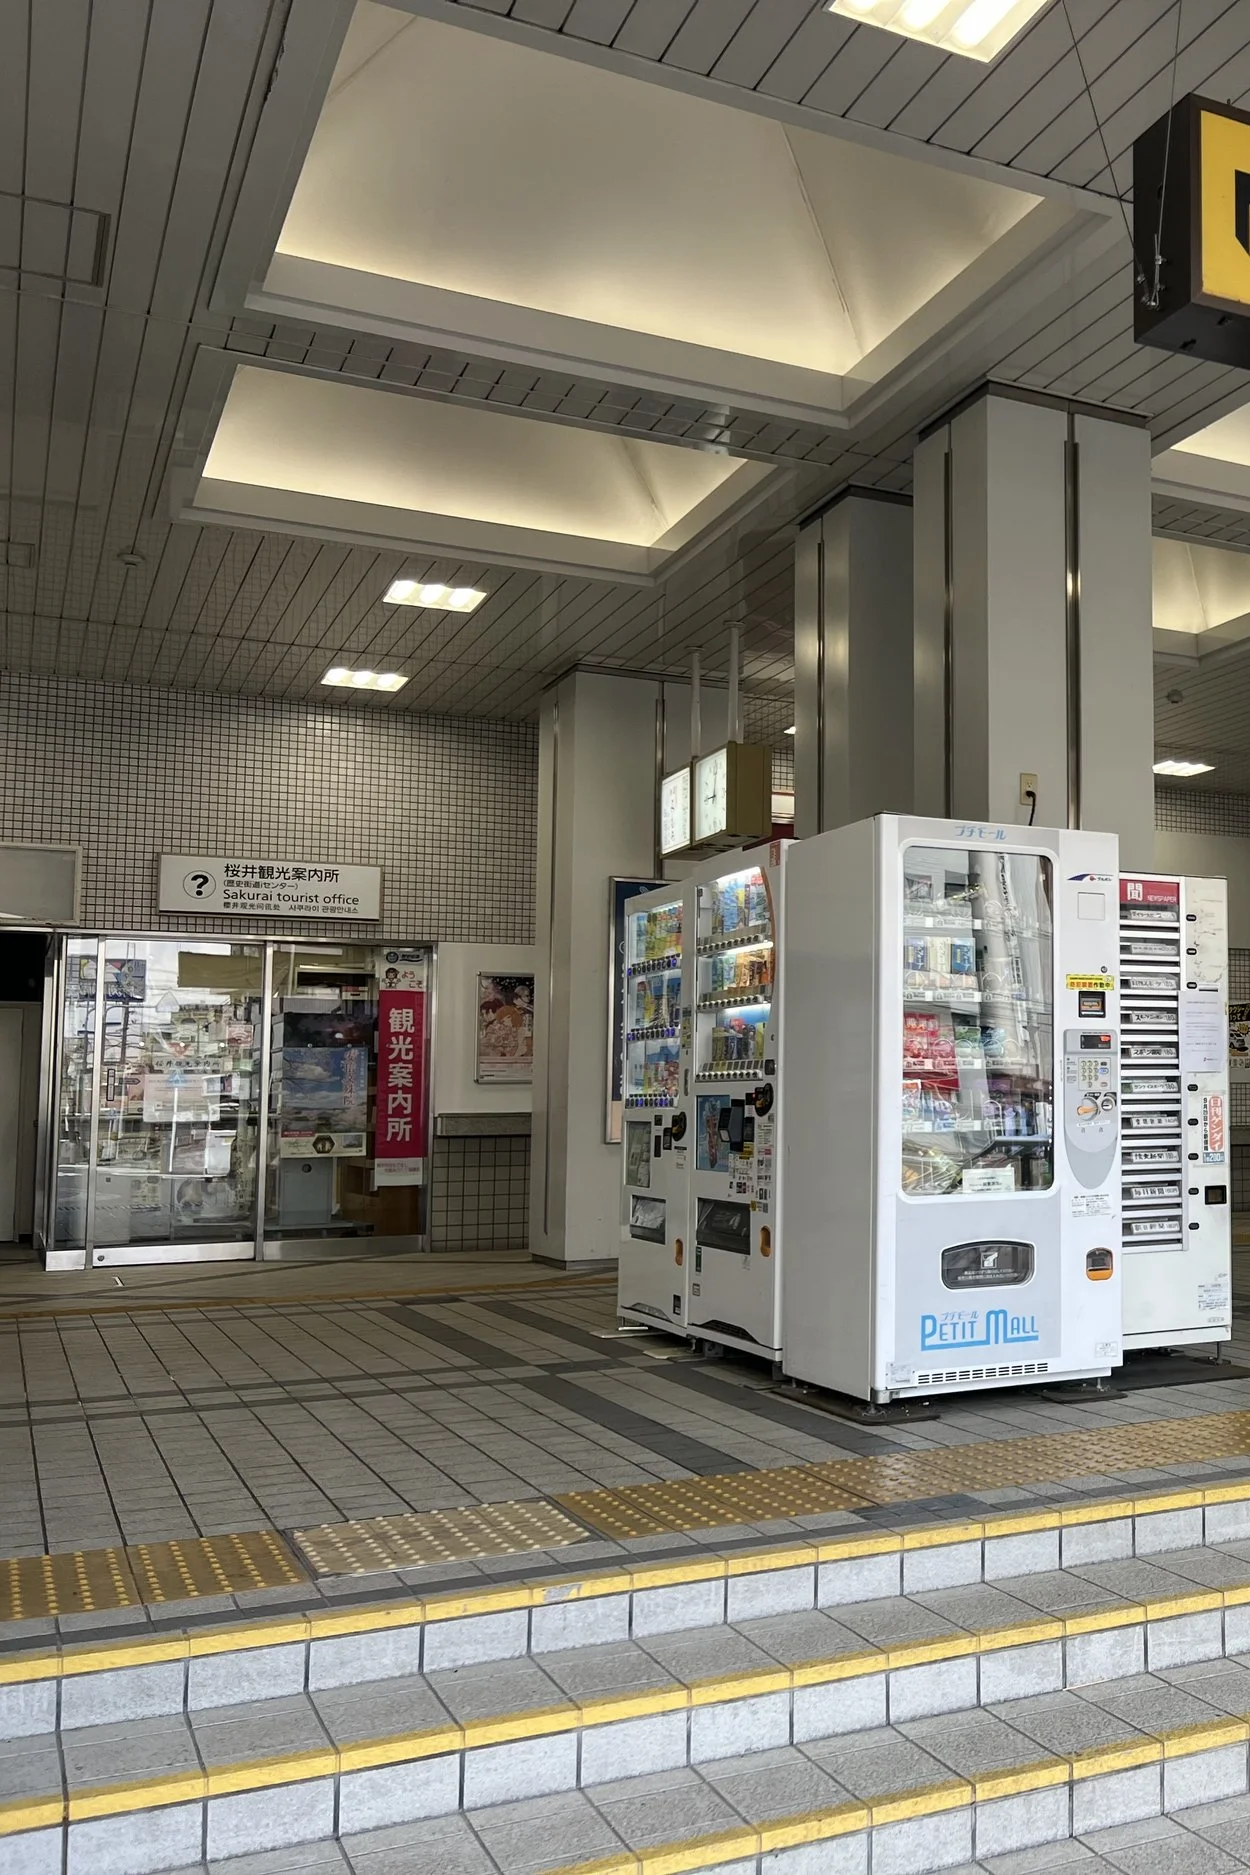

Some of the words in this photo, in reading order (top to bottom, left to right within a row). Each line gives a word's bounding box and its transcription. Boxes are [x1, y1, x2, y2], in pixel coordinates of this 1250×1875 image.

[954, 825, 1007, 840] プチモール
[224, 863, 339, 883] 桜井観光案内所
[223, 889, 273, 901] Sakurai
[277, 892, 319, 903] tourist
[323, 894, 360, 905] office
[1127, 883, 1143, 900] 聞
[386, 1008, 415, 1142] 観光案内所
